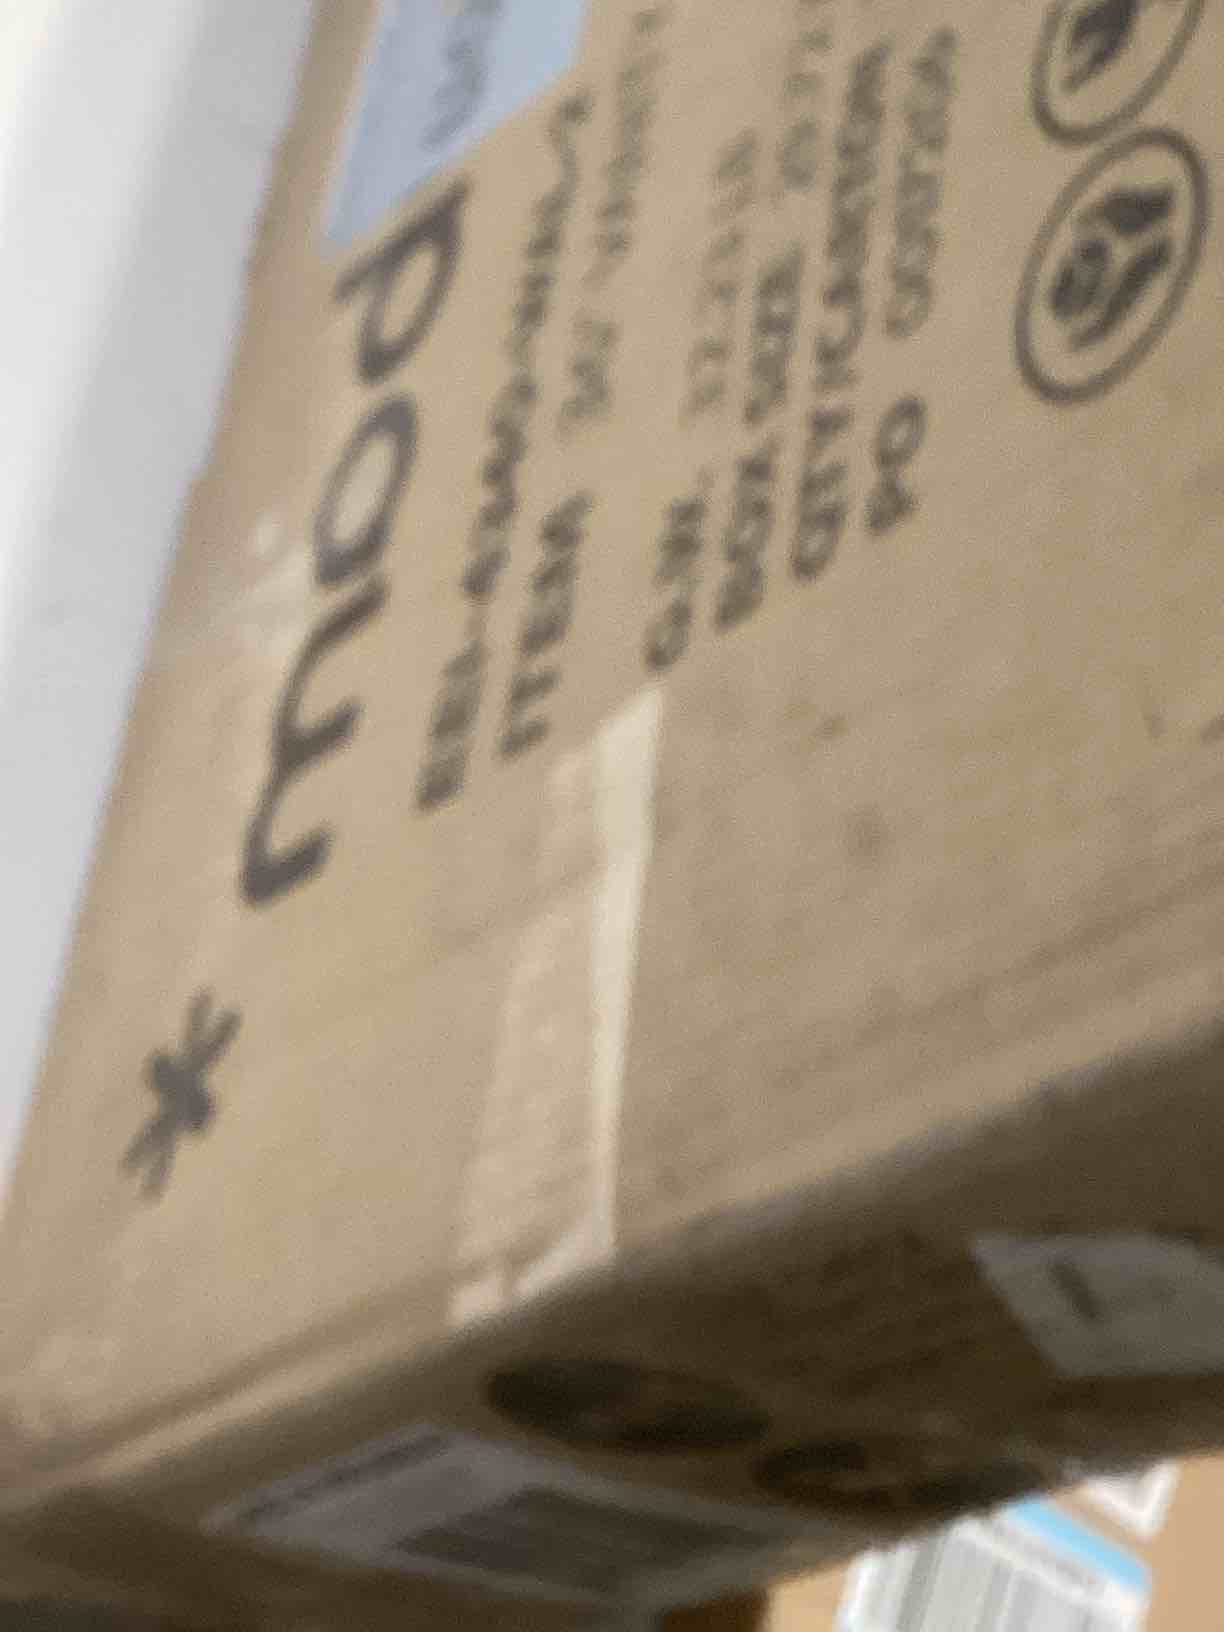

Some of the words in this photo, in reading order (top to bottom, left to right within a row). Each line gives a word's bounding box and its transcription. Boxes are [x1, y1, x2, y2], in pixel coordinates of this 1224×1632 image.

[710, 420, 784, 636] BOX
[862, 382, 929, 547] PO
[497, 486, 597, 761] ITEM
